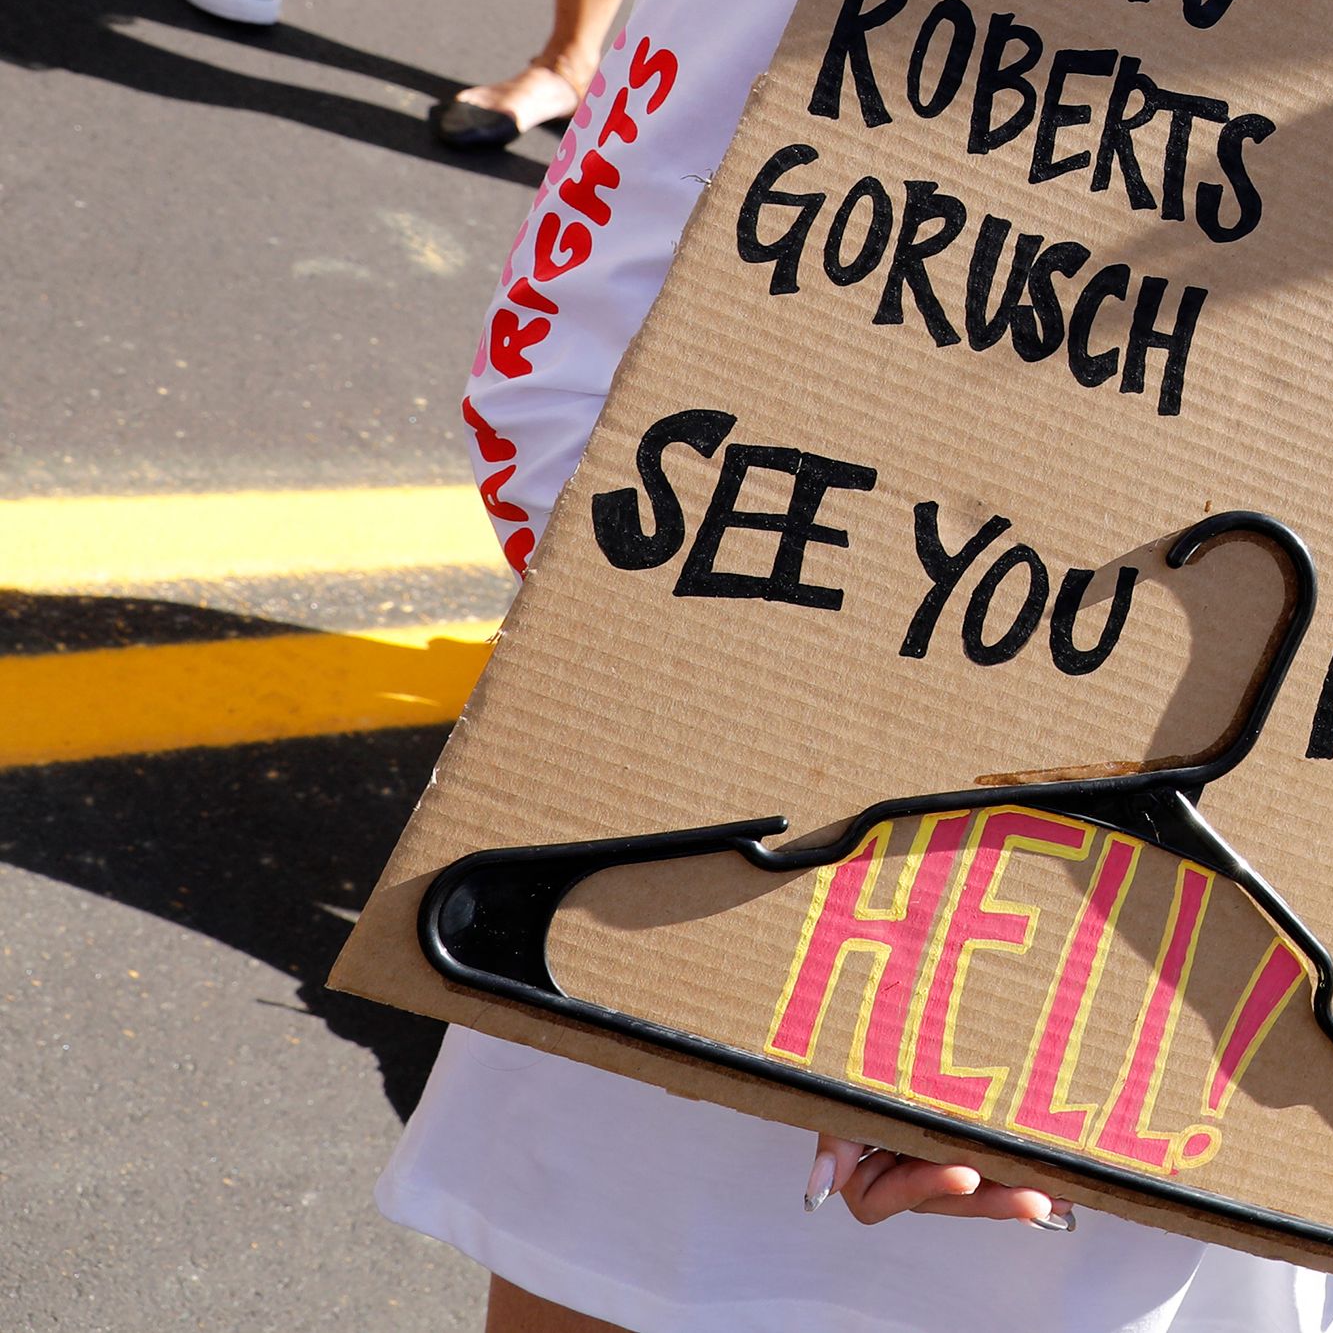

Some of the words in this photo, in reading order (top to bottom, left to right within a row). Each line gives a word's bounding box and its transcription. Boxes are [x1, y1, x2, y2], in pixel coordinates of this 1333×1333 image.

[489, 36, 679, 380] RIGHTS
[735, 142, 1209, 417] GORUSCH
[591, 408, 878, 612] SEE
[898, 500, 1140, 676] YOU
[764, 803, 1308, 1176] HELL!
